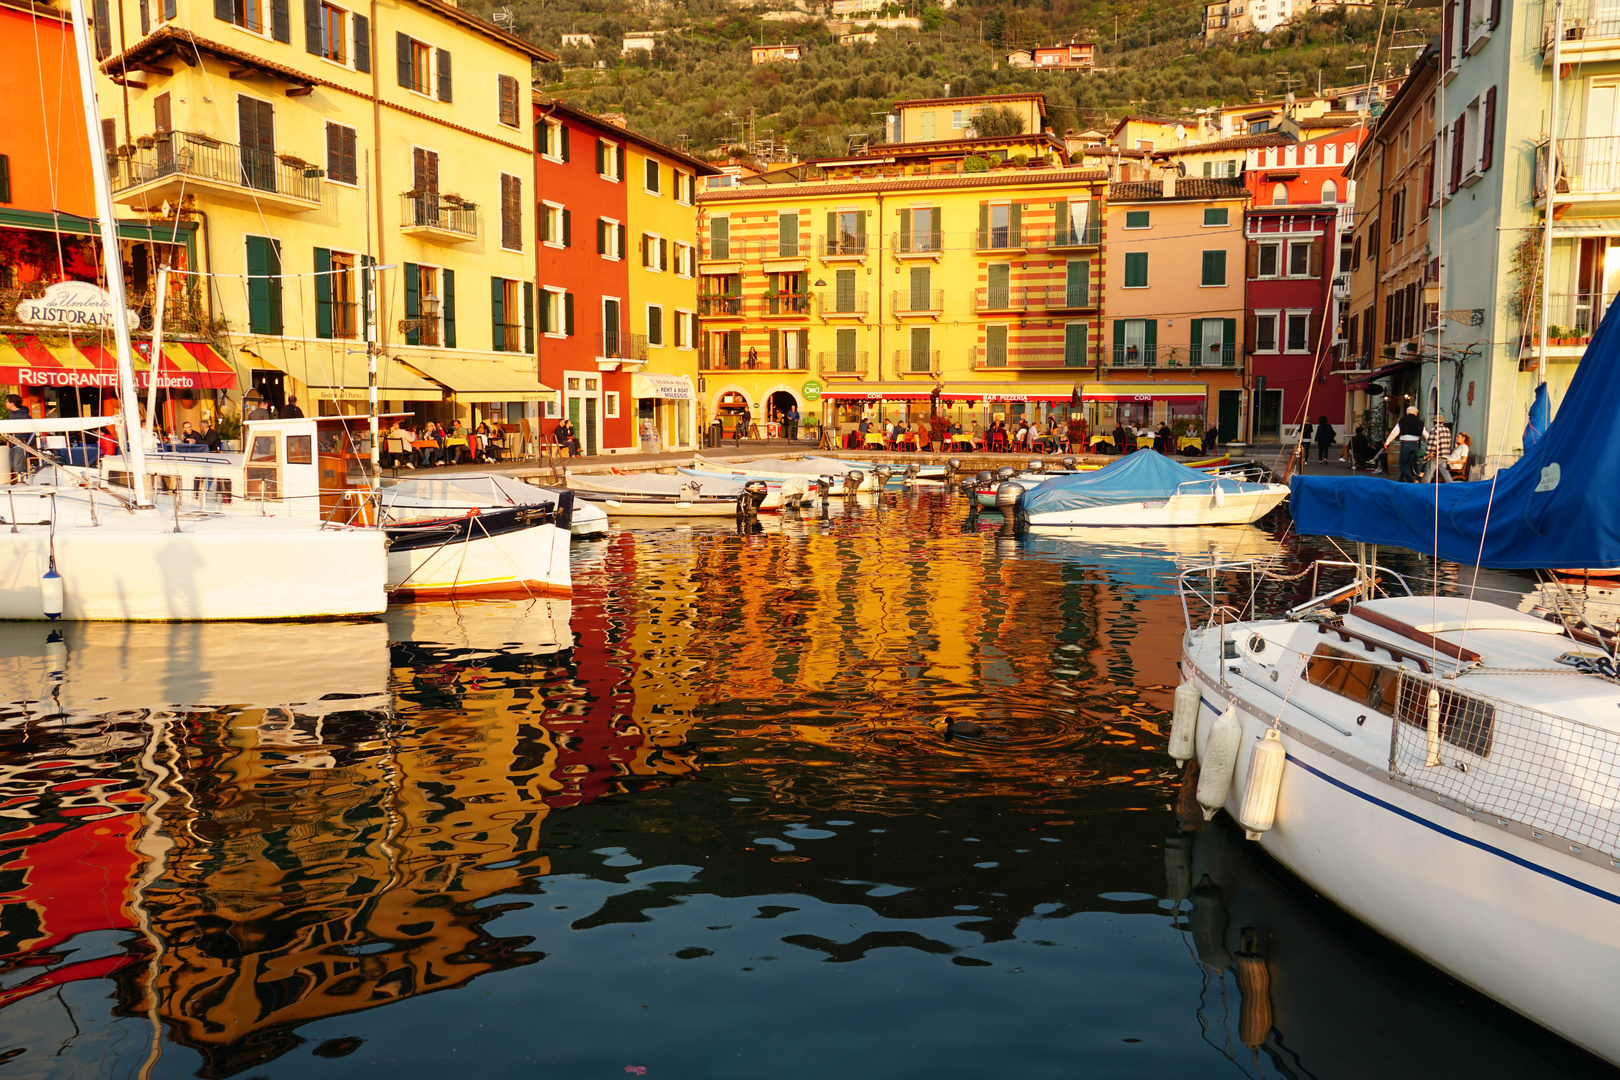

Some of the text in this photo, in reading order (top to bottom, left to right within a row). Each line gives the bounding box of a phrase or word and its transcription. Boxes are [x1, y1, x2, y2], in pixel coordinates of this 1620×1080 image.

[46, 291, 110, 308] da Umberto
[31, 306, 114, 326] RISTORAN
